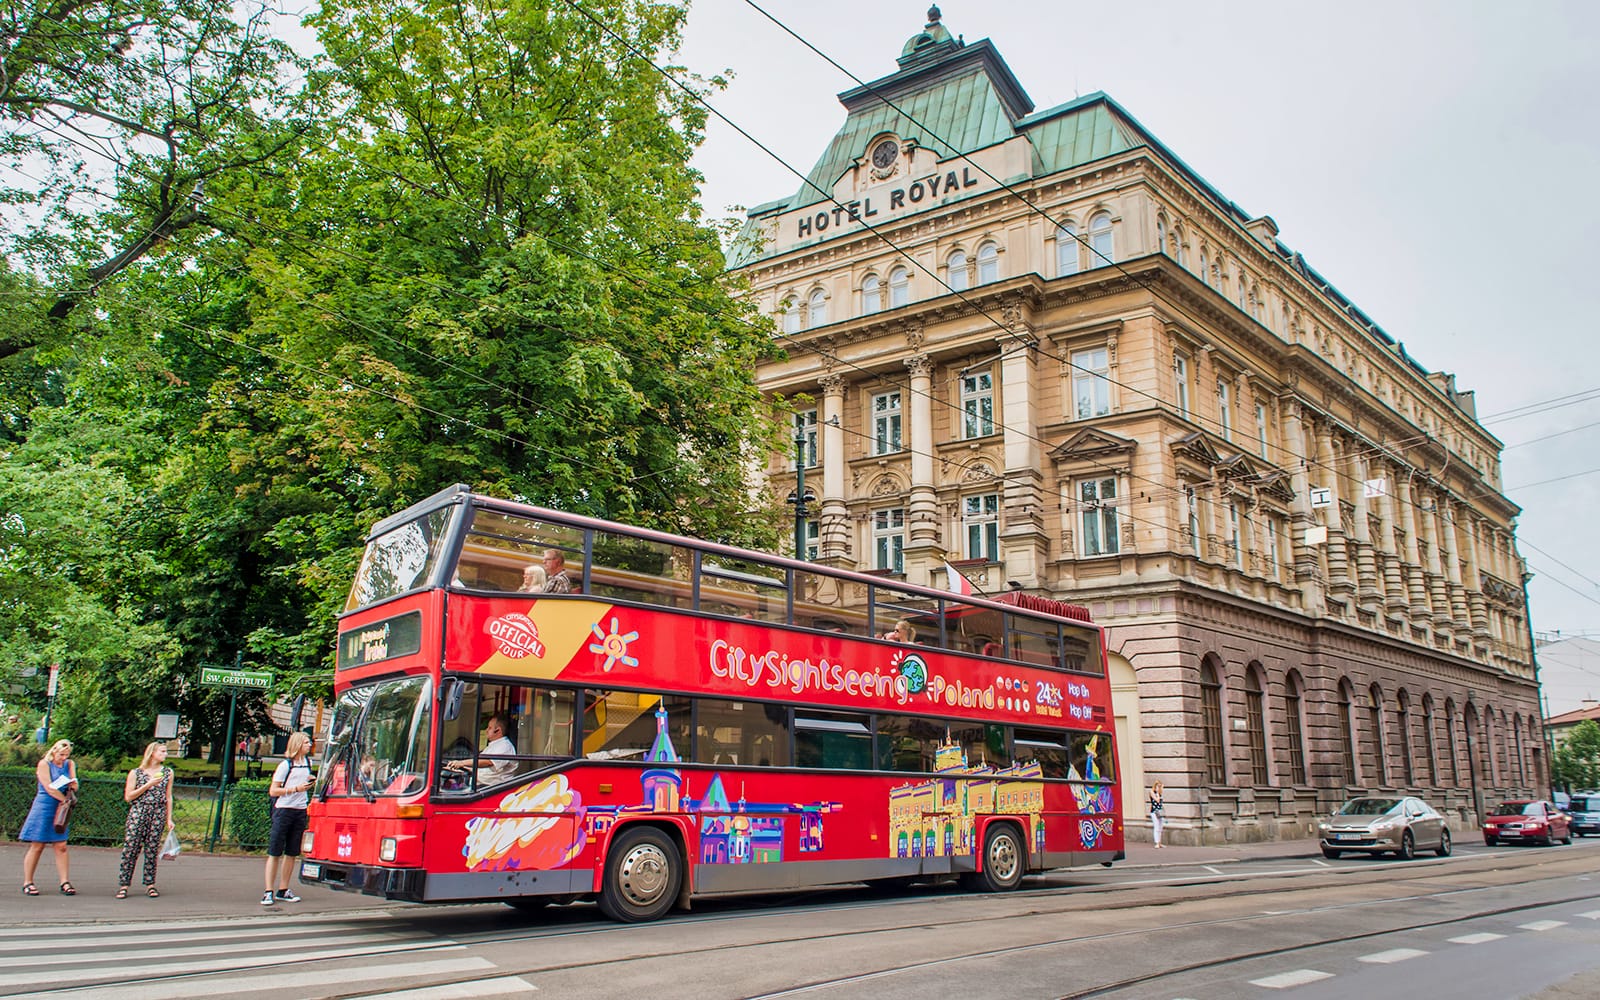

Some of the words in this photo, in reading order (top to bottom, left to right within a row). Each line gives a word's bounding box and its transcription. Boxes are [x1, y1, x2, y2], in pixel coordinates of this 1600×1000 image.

[798, 198, 877, 238] HOTEL
[890, 167, 977, 210] ROYAL
[489, 620, 542, 657] OFFICIAL
[499, 641, 525, 658] TOUR
[222, 675, 269, 686] GERTRUDY
[709, 639, 909, 705] CitySightseeing
[932, 674, 994, 710] Poland
[1035, 681, 1052, 704] 24
[1068, 682, 1081, 698] Hop
[1081, 683, 1090, 699] On
[1070, 703, 1082, 719] Hop
[1082, 704, 1093, 720] Off
